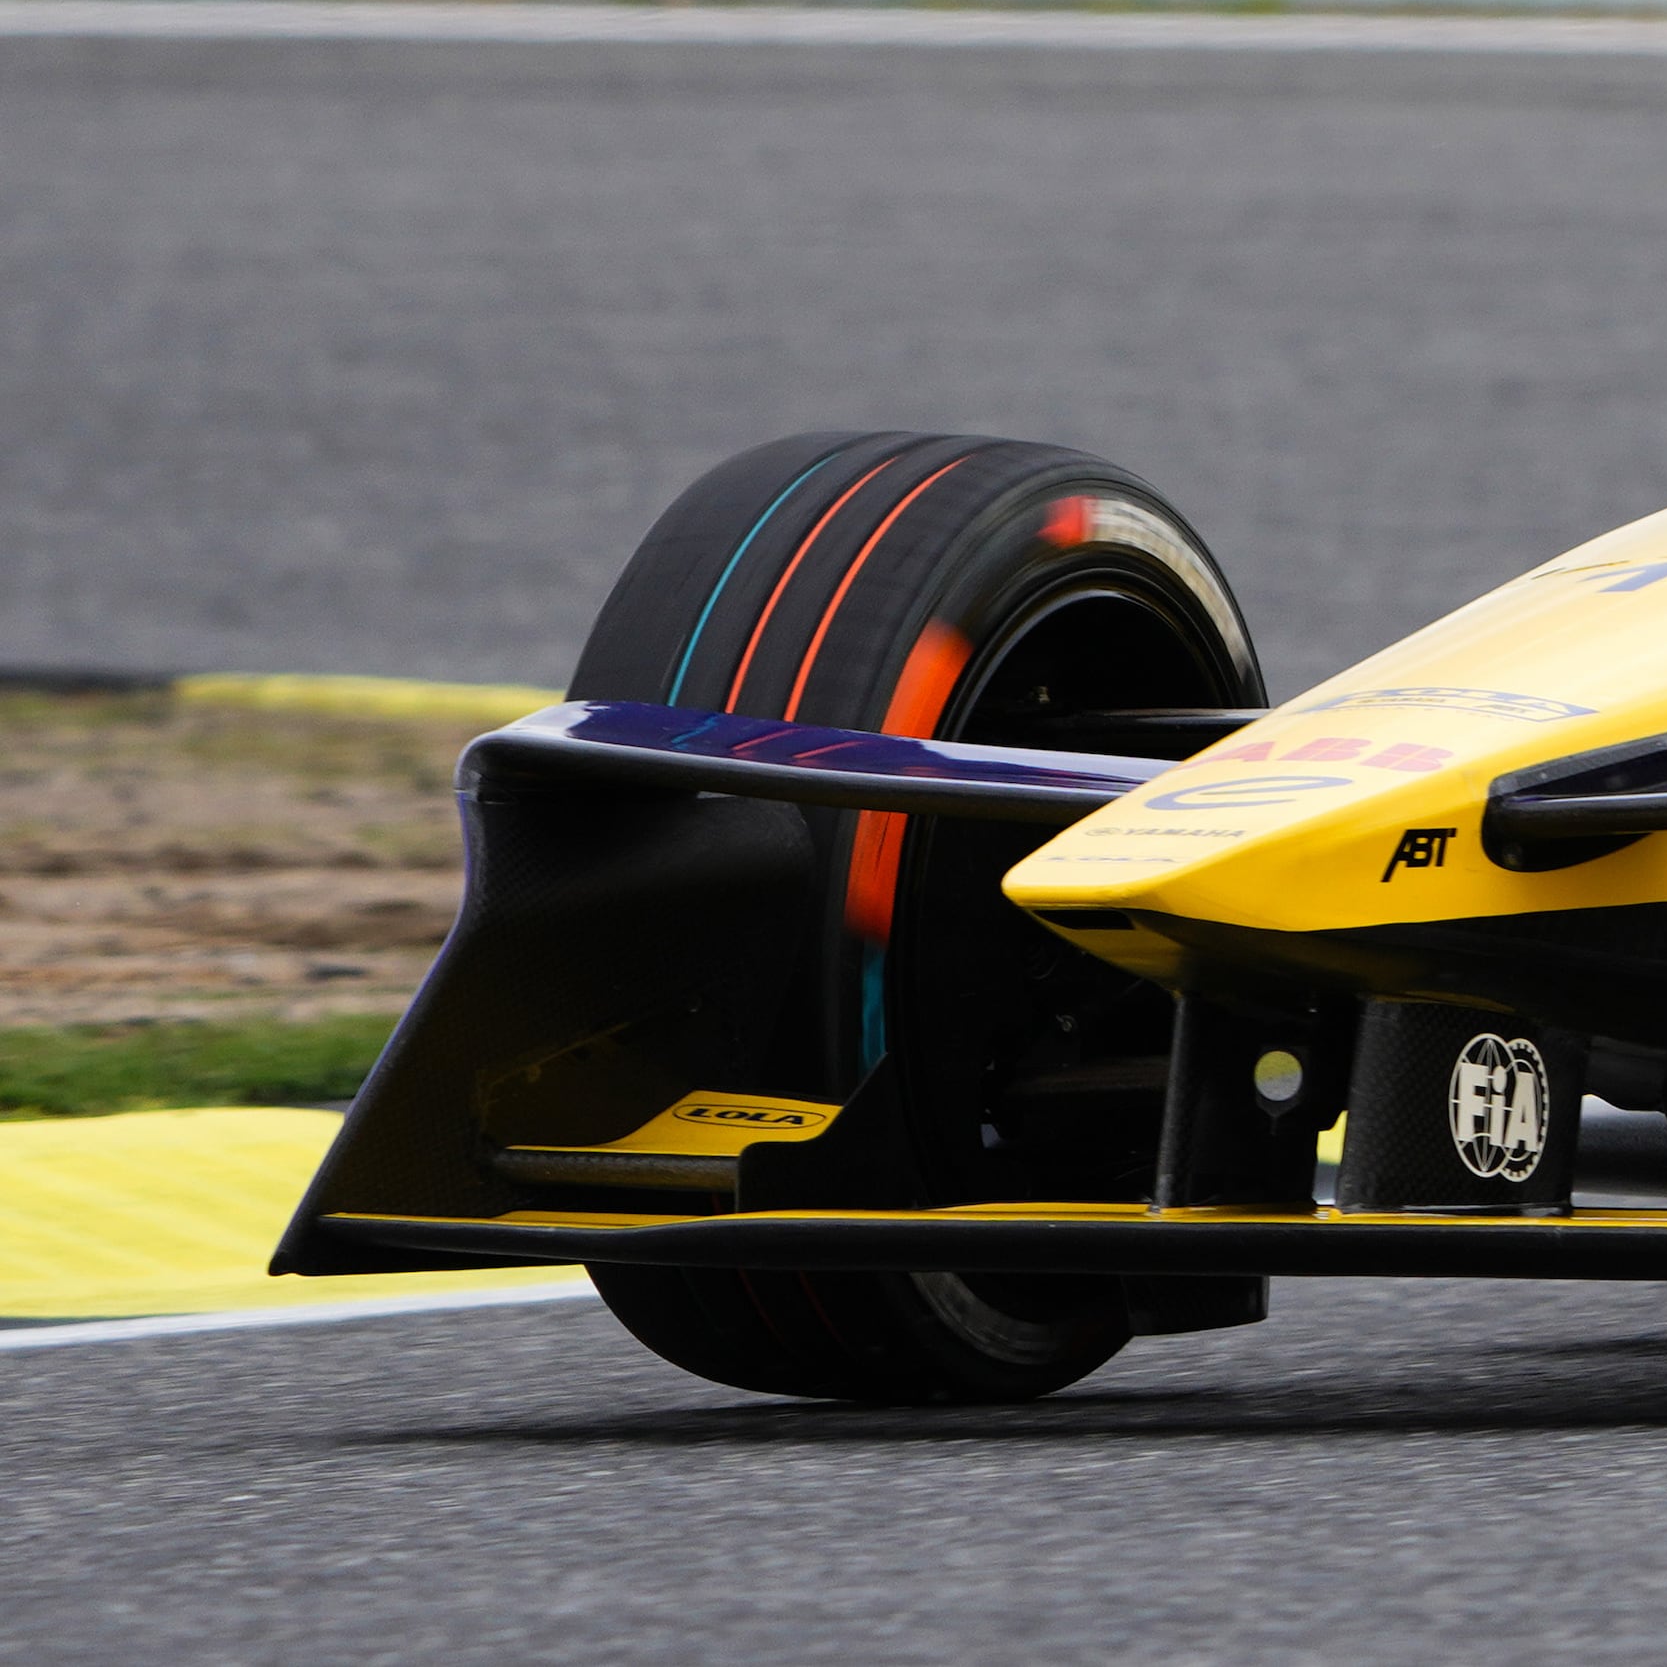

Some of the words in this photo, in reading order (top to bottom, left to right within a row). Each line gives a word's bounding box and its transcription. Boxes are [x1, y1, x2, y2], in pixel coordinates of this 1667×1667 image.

[1172, 737, 1454, 772] ABB
[1380, 827, 1457, 883] ABT
[686, 1107, 805, 1126] LOLA
